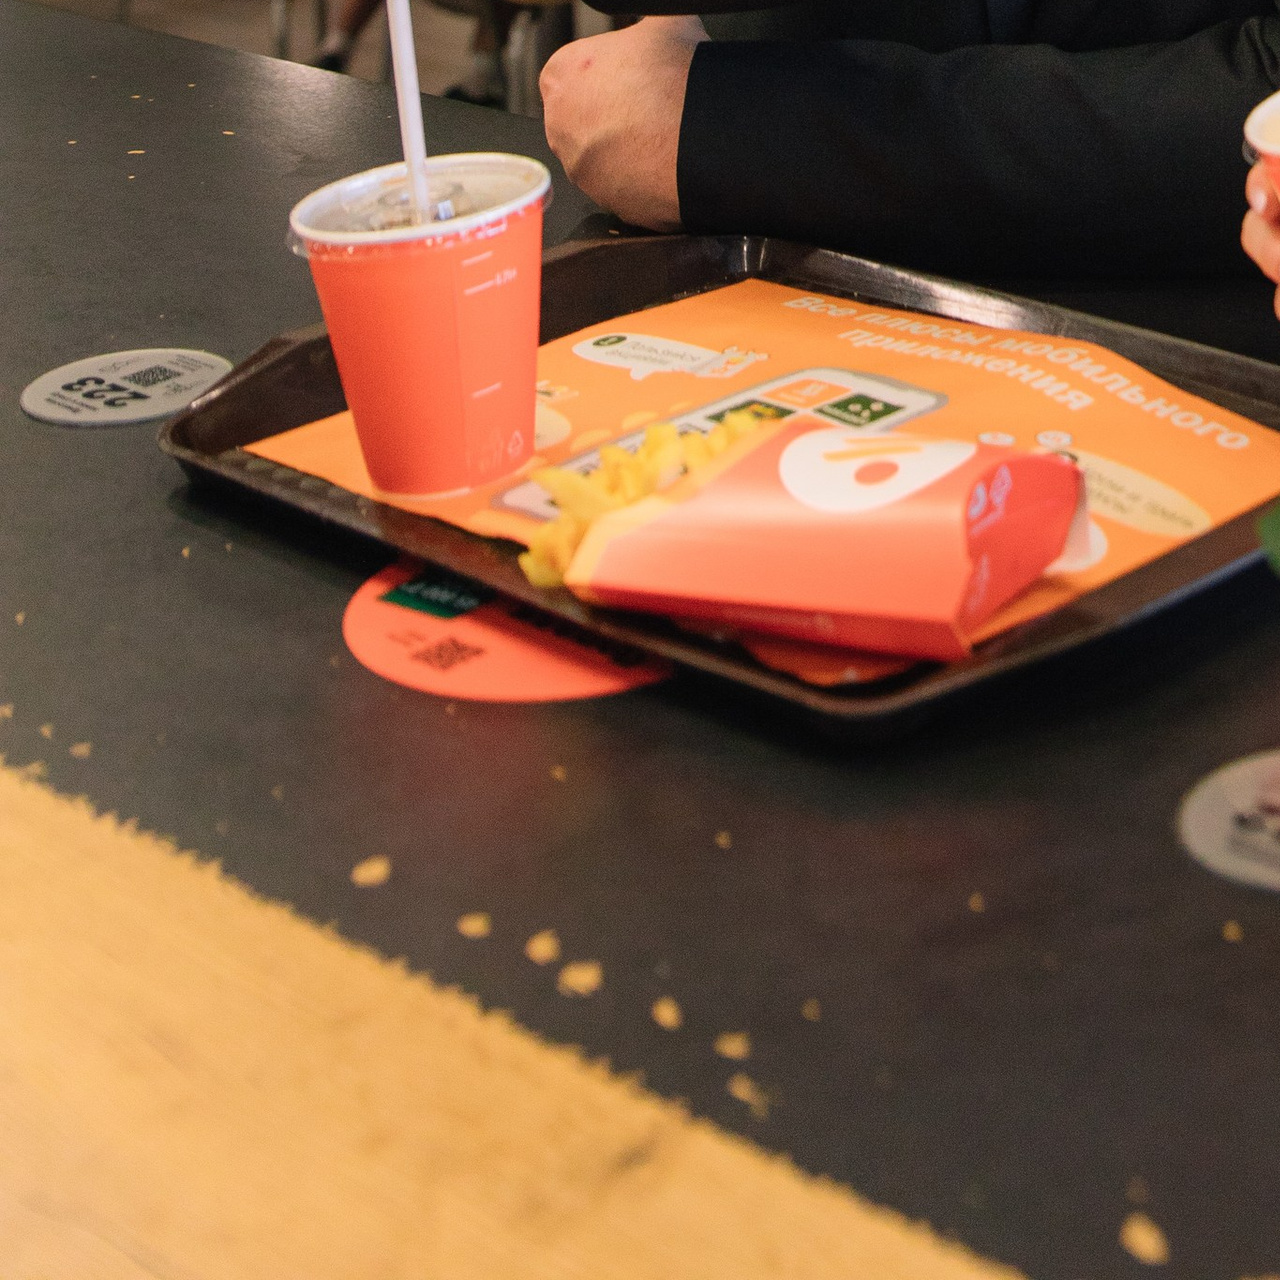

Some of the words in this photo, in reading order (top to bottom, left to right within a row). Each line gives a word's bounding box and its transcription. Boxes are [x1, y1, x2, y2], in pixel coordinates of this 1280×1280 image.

[61, 377, 150, 409] 223
[783, 295, 857, 319] Все
[855, 308, 994, 346] плюсы
[993, 337, 1250, 450] мобильного
[837, 327, 1096, 412] приложения
